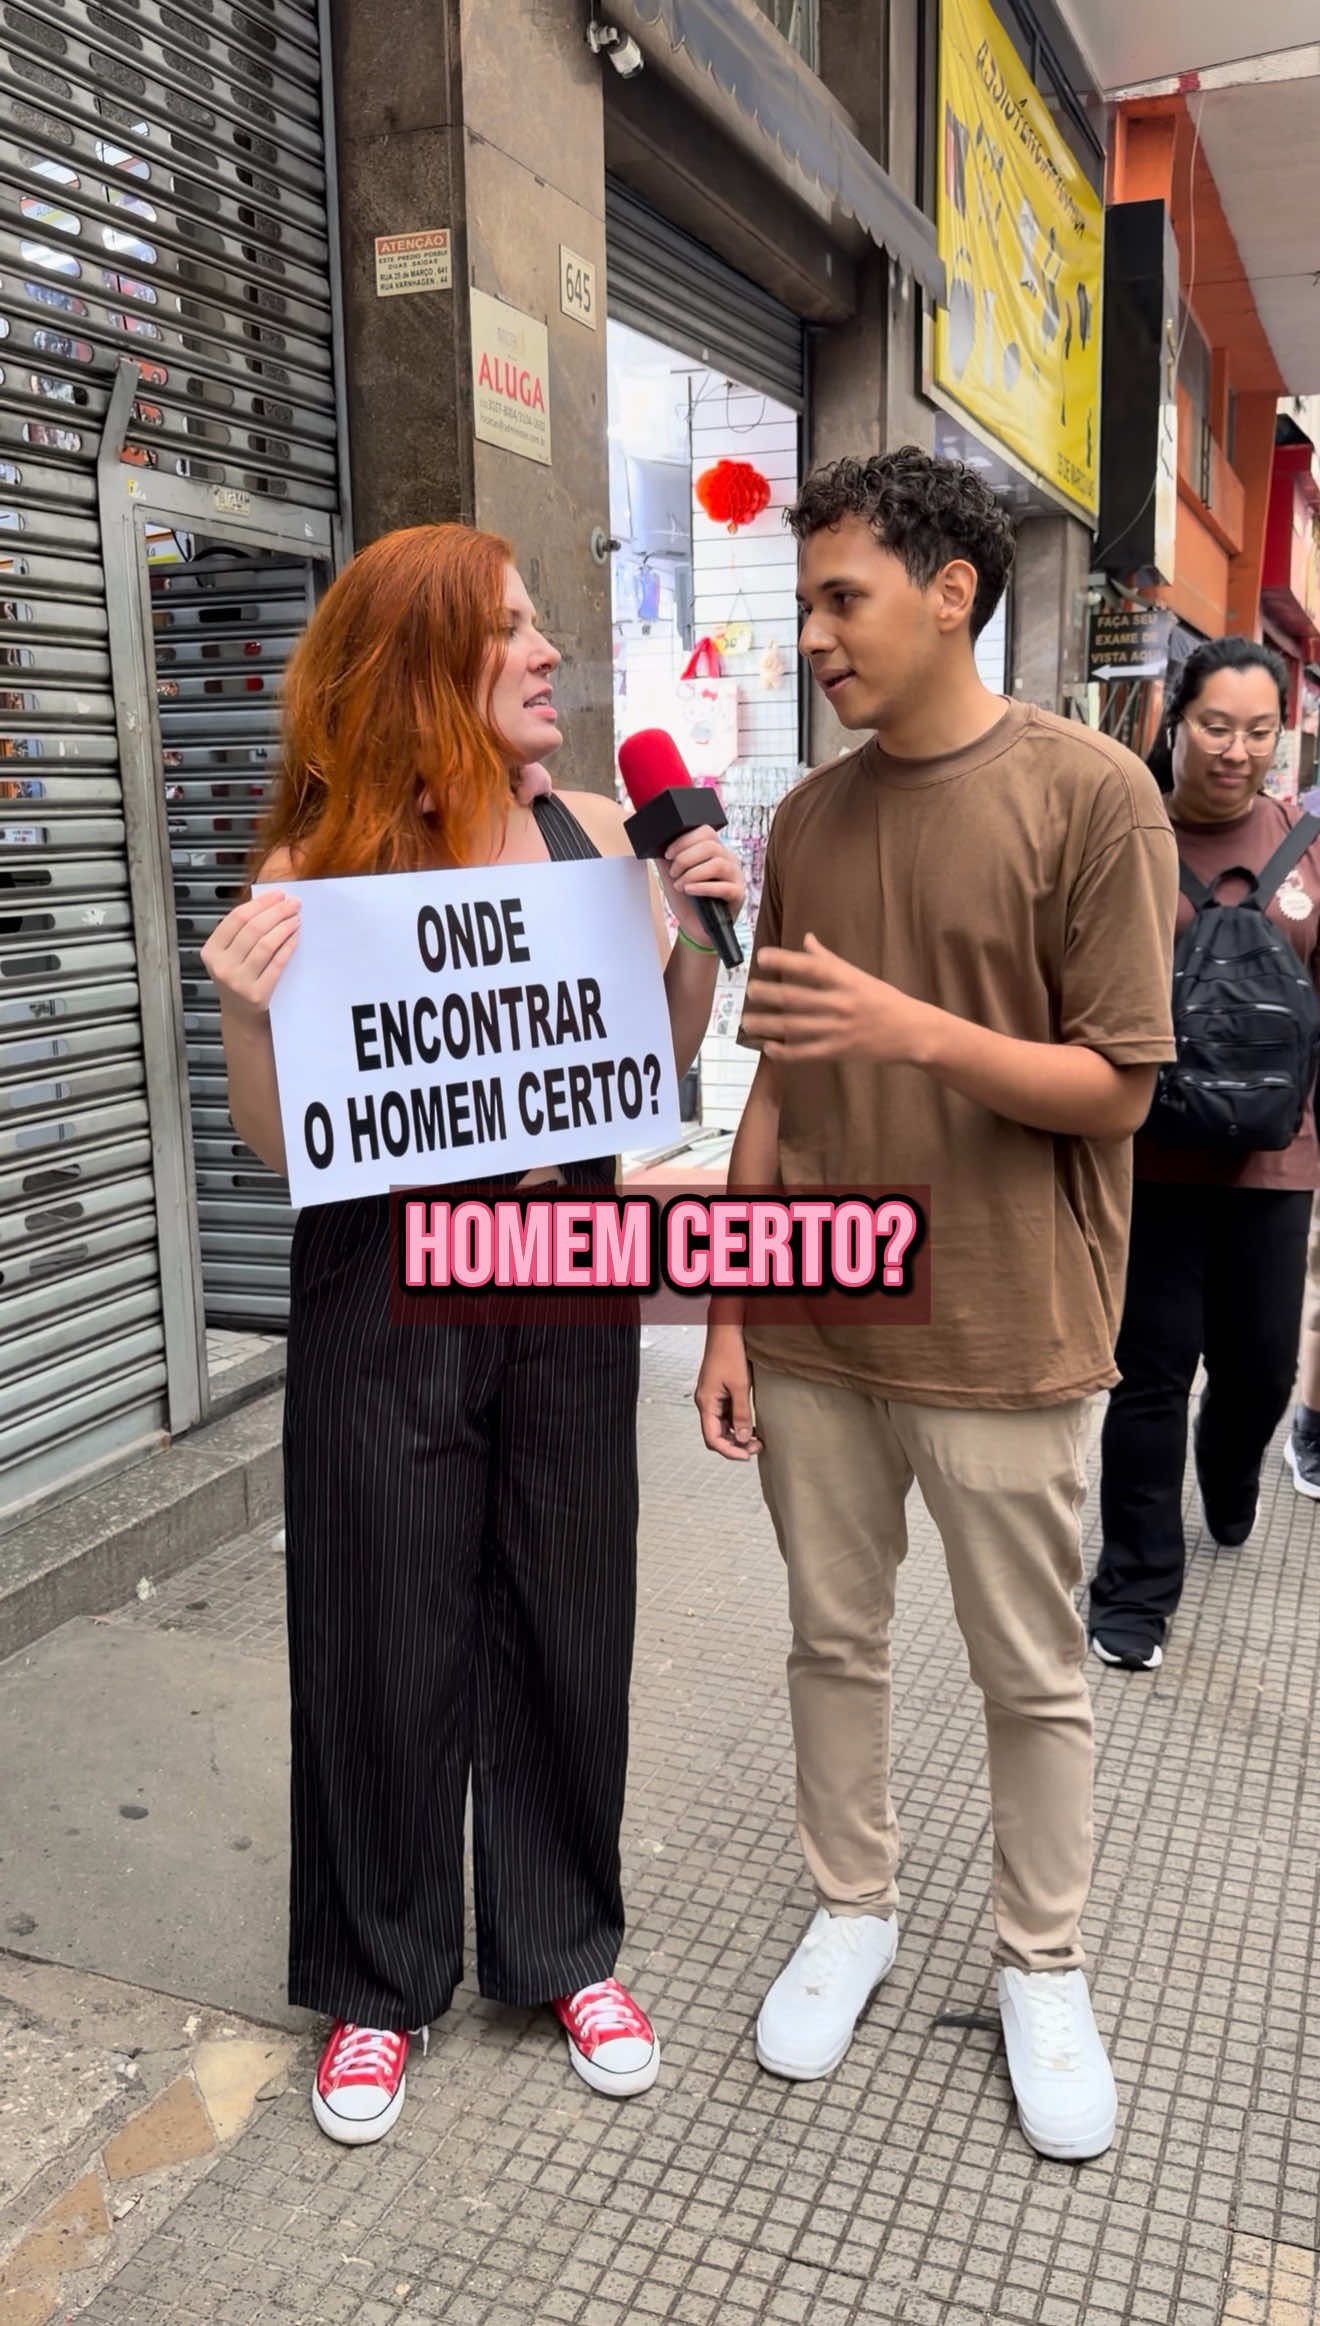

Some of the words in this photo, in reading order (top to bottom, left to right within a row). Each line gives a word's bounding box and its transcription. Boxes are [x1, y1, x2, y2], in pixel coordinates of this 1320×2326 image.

[382, 234, 444, 252] ATENÇÃO
[379, 256, 393, 264] ESTE
[388, 262, 407, 270] DUAS
[380, 273, 393, 281] RUA
[566, 262, 591, 312] 645
[478, 351, 545, 414] ALUGA
[1097, 615, 1129, 629] FAÇA
[1132, 613, 1158, 625] SEU
[1095, 632, 1138, 646] EXAME
[1091, 652, 1127, 664] VISTA
[417, 898, 530, 973] ONDE
[352, 978, 607, 1072] ENCONTRAR
[304, 1102, 334, 1170] O
[347, 1077, 507, 1163] HOMEM
[518, 1053, 661, 1136] CERTO?
